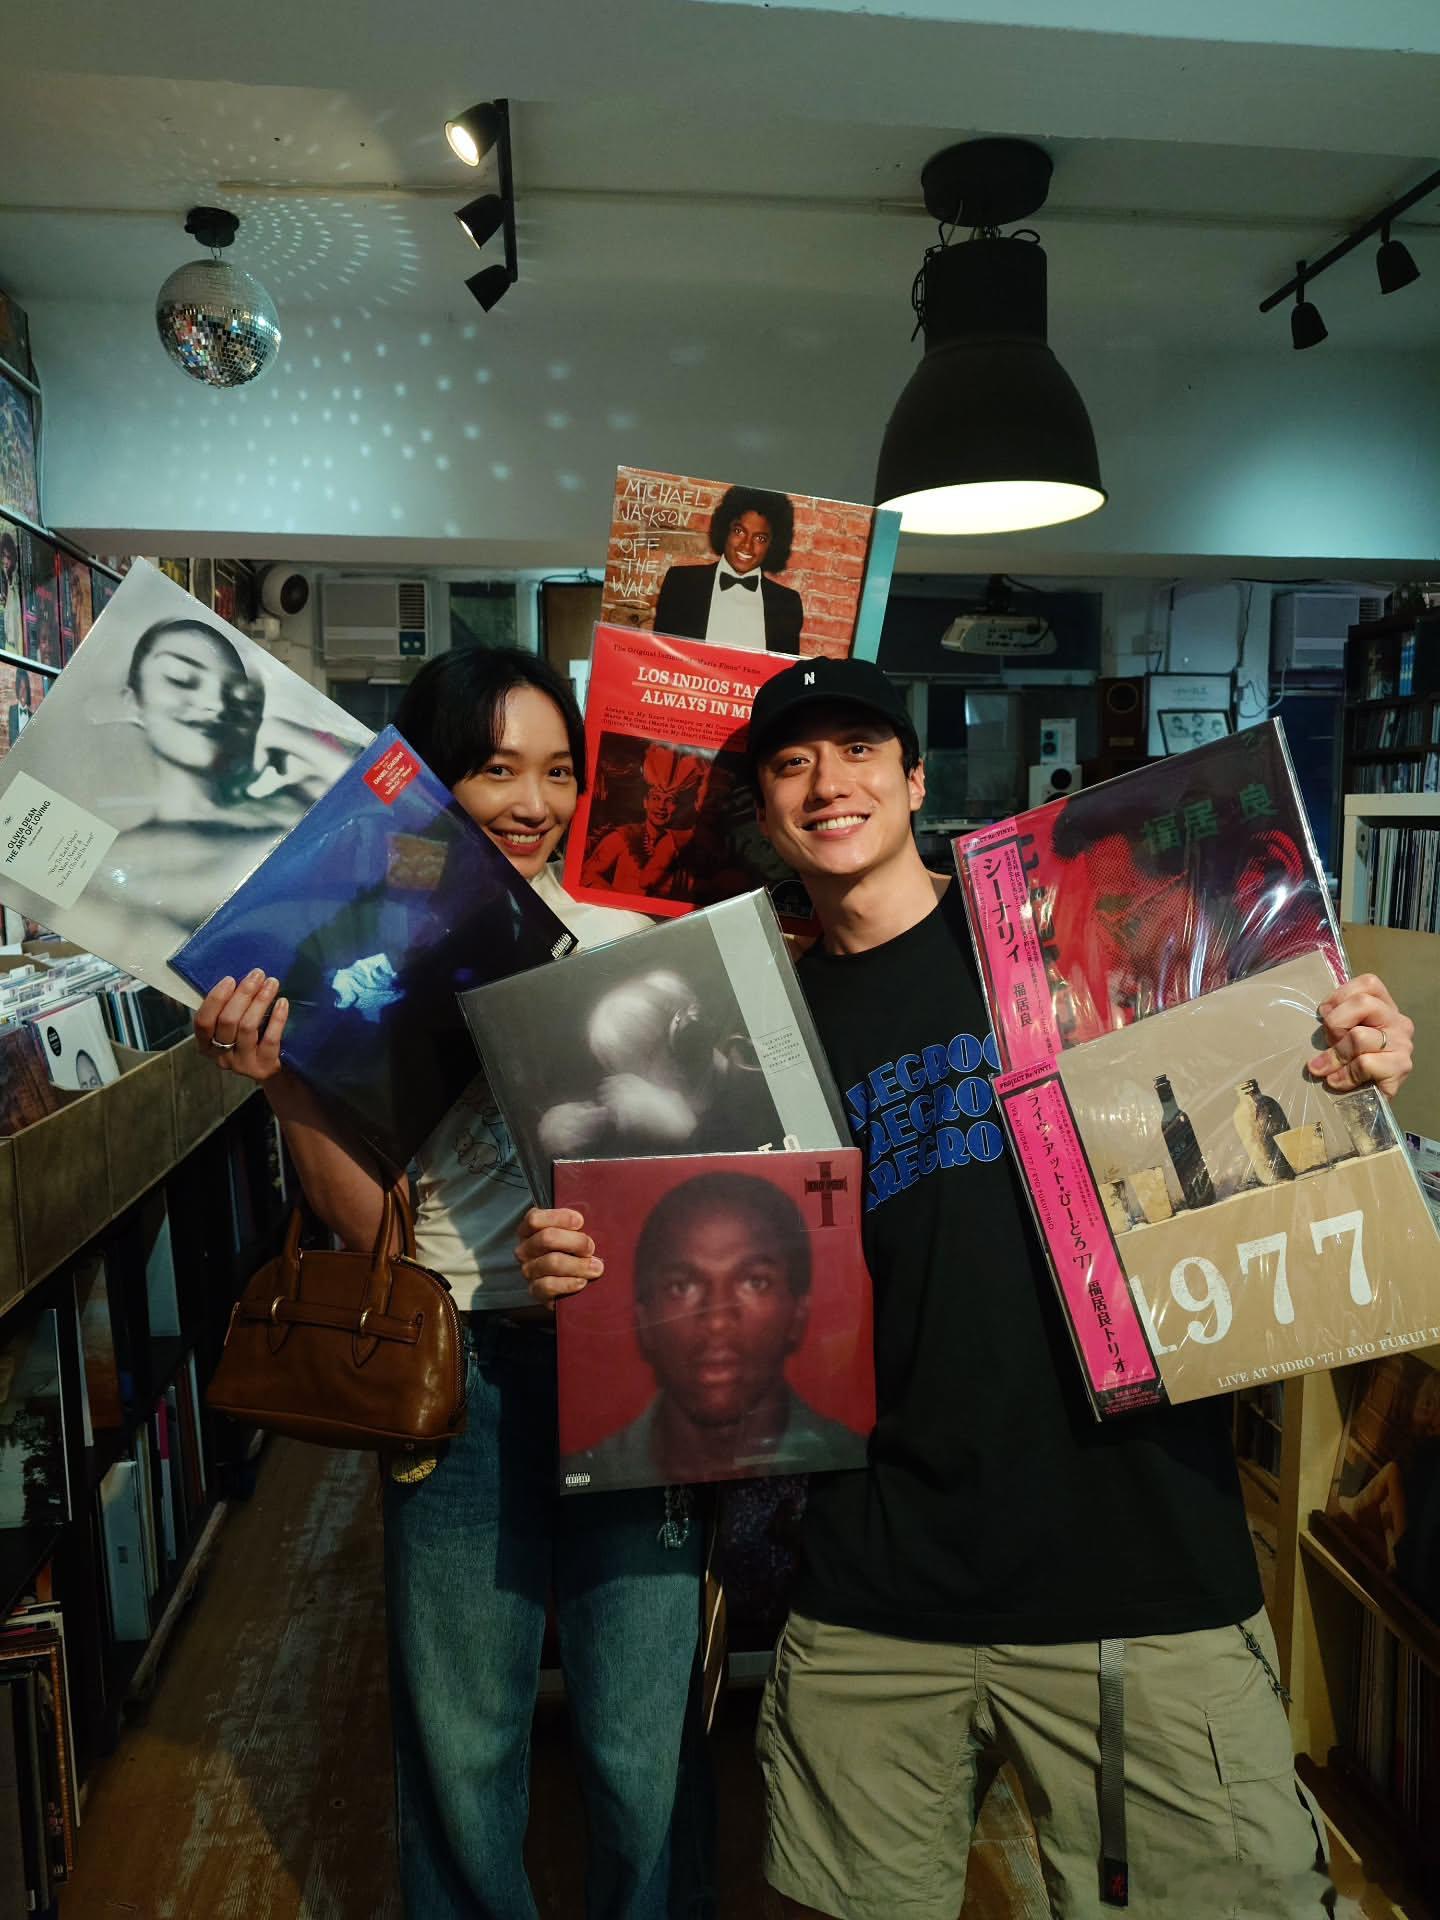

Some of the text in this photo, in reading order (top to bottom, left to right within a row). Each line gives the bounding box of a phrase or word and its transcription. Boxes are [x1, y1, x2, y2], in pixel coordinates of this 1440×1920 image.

[623, 480, 706, 506] MICHAEL
[621, 503, 693, 528] JACKSON
[620, 538, 660, 558] OFF
[623, 558, 658, 575] THE
[612, 575, 656, 598] WALL
[637, 667, 670, 684] LOS
[672, 673, 729, 694] INDIOS
[804, 671, 815, 685] N
[641, 689, 706, 712] ALWAYS
[709, 702, 728, 716] IN
[6, 849, 19, 863] THE
[16, 834, 28, 850] ART
[24, 824, 33, 836] OF
[31, 800, 51, 826] LOVING
[8, 827, 26, 848] OLIVIA
[22, 807, 37, 827] DEAN
[1013, 981, 1033, 1028] 福居良
[1018, 1128, 1030, 1152] VIDRO
[1129, 1209, 1374, 1356] 1977
[1087, 1279, 1126, 1373] 福居良トリオ
[1217, 1371, 1249, 1388] LIVE
[1251, 1366, 1270, 1380] AT
[1271, 1357, 1315, 1375] VIDRO
[1346, 1343, 1376, 1358] RYO
[1378, 1330, 1428, 1351] FUKUI
